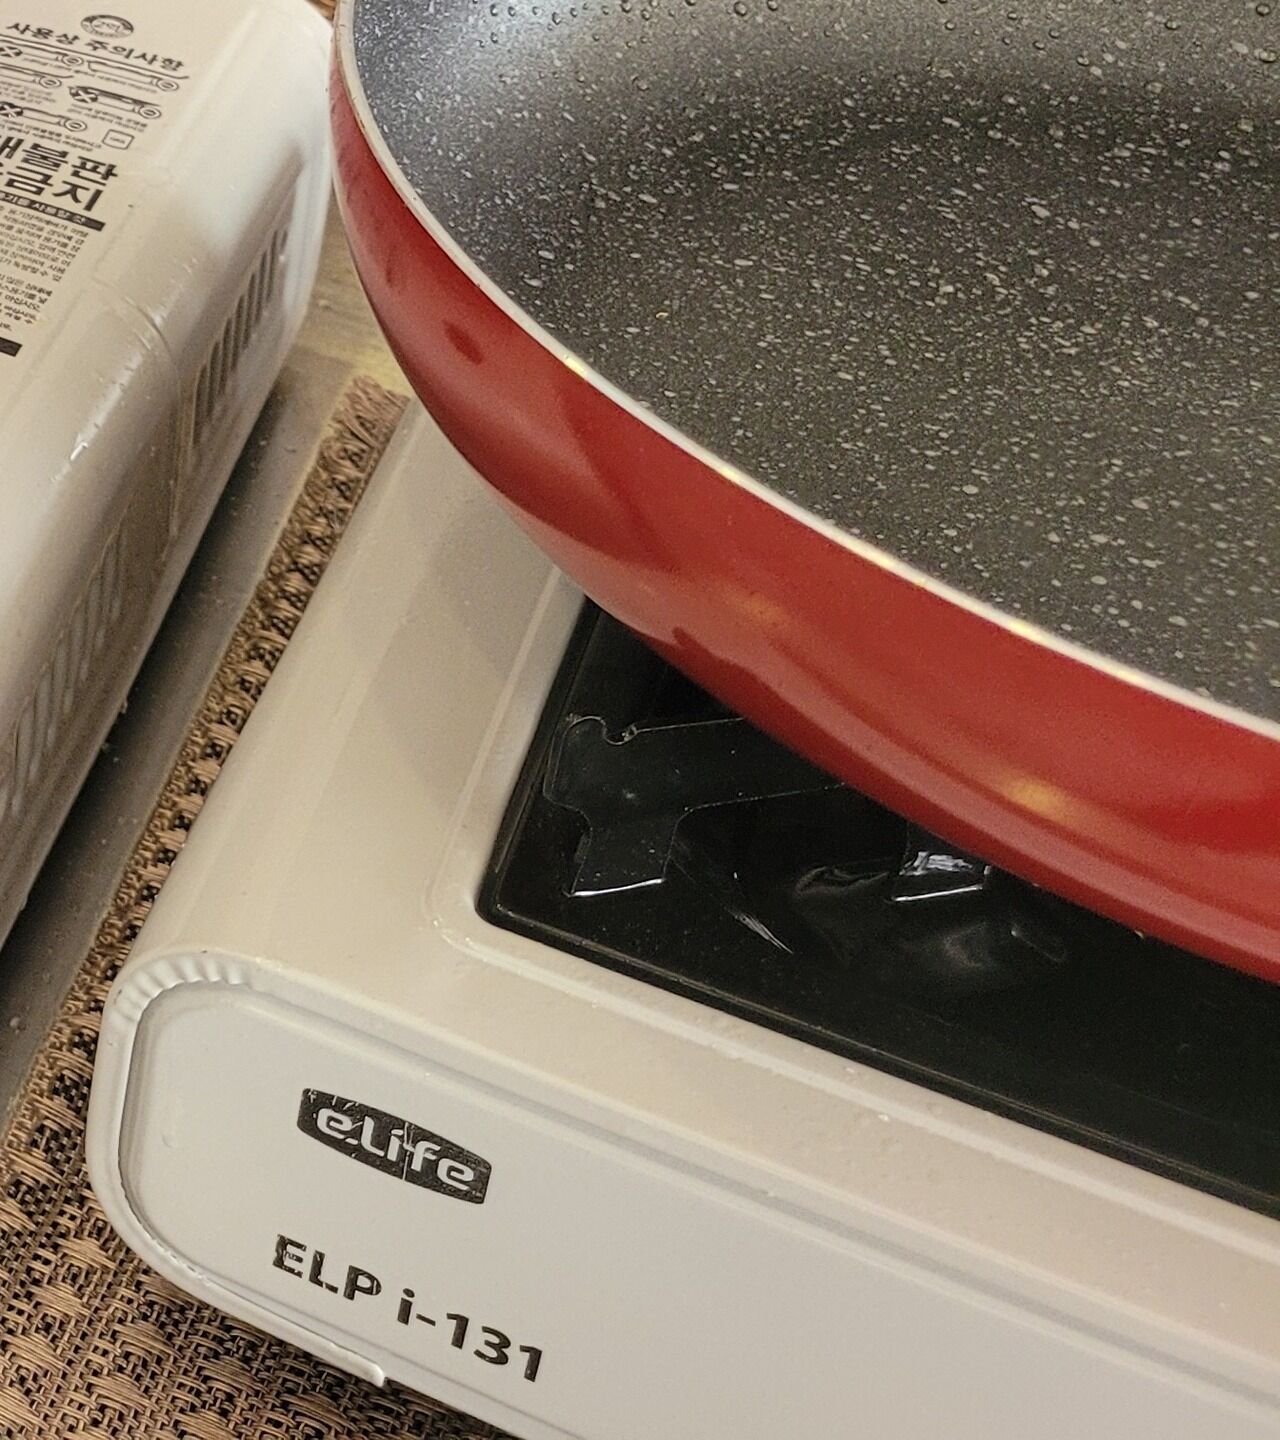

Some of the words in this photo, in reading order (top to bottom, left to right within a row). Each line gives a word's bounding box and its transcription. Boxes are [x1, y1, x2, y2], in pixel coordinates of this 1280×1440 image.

[6, 22, 80, 45] 사용상
[85, 39, 184, 71] 주의사항
[314, 1106, 475, 1192] eLife
[272, 1234, 383, 1301] ELP
[396, 1288, 543, 1383] i-131
